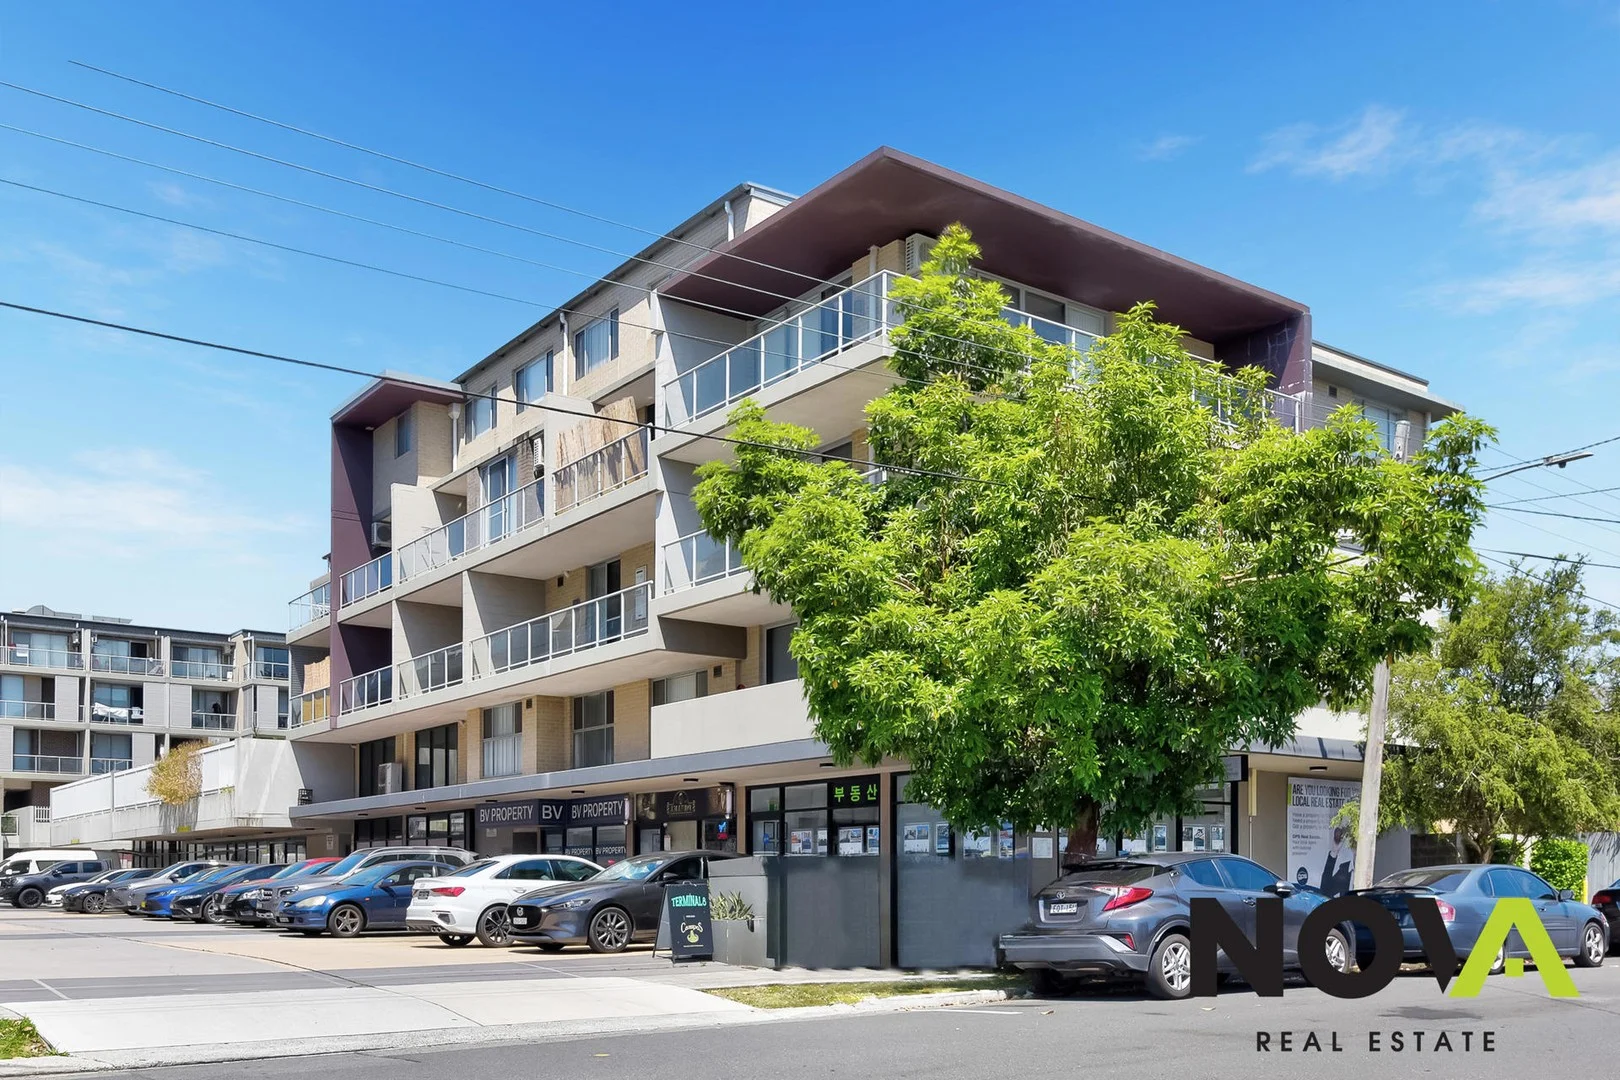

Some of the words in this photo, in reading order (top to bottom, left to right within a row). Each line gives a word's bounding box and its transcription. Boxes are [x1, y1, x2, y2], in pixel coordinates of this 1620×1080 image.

[834, 784, 877, 802] 부동산
[1292, 784, 1303, 795] ARE
[1305, 784, 1316, 796] YOU
[1317, 785, 1340, 797] LOOKING
[571, 805, 582, 819] BV
[582, 800, 623, 818] PROPERTY
[1292, 796, 1310, 807] LOCAL
[1311, 797, 1325, 808] REAL
[480, 809, 489, 822] BV
[491, 805, 533, 821] PROPERTY
[542, 805, 563, 819] BV
